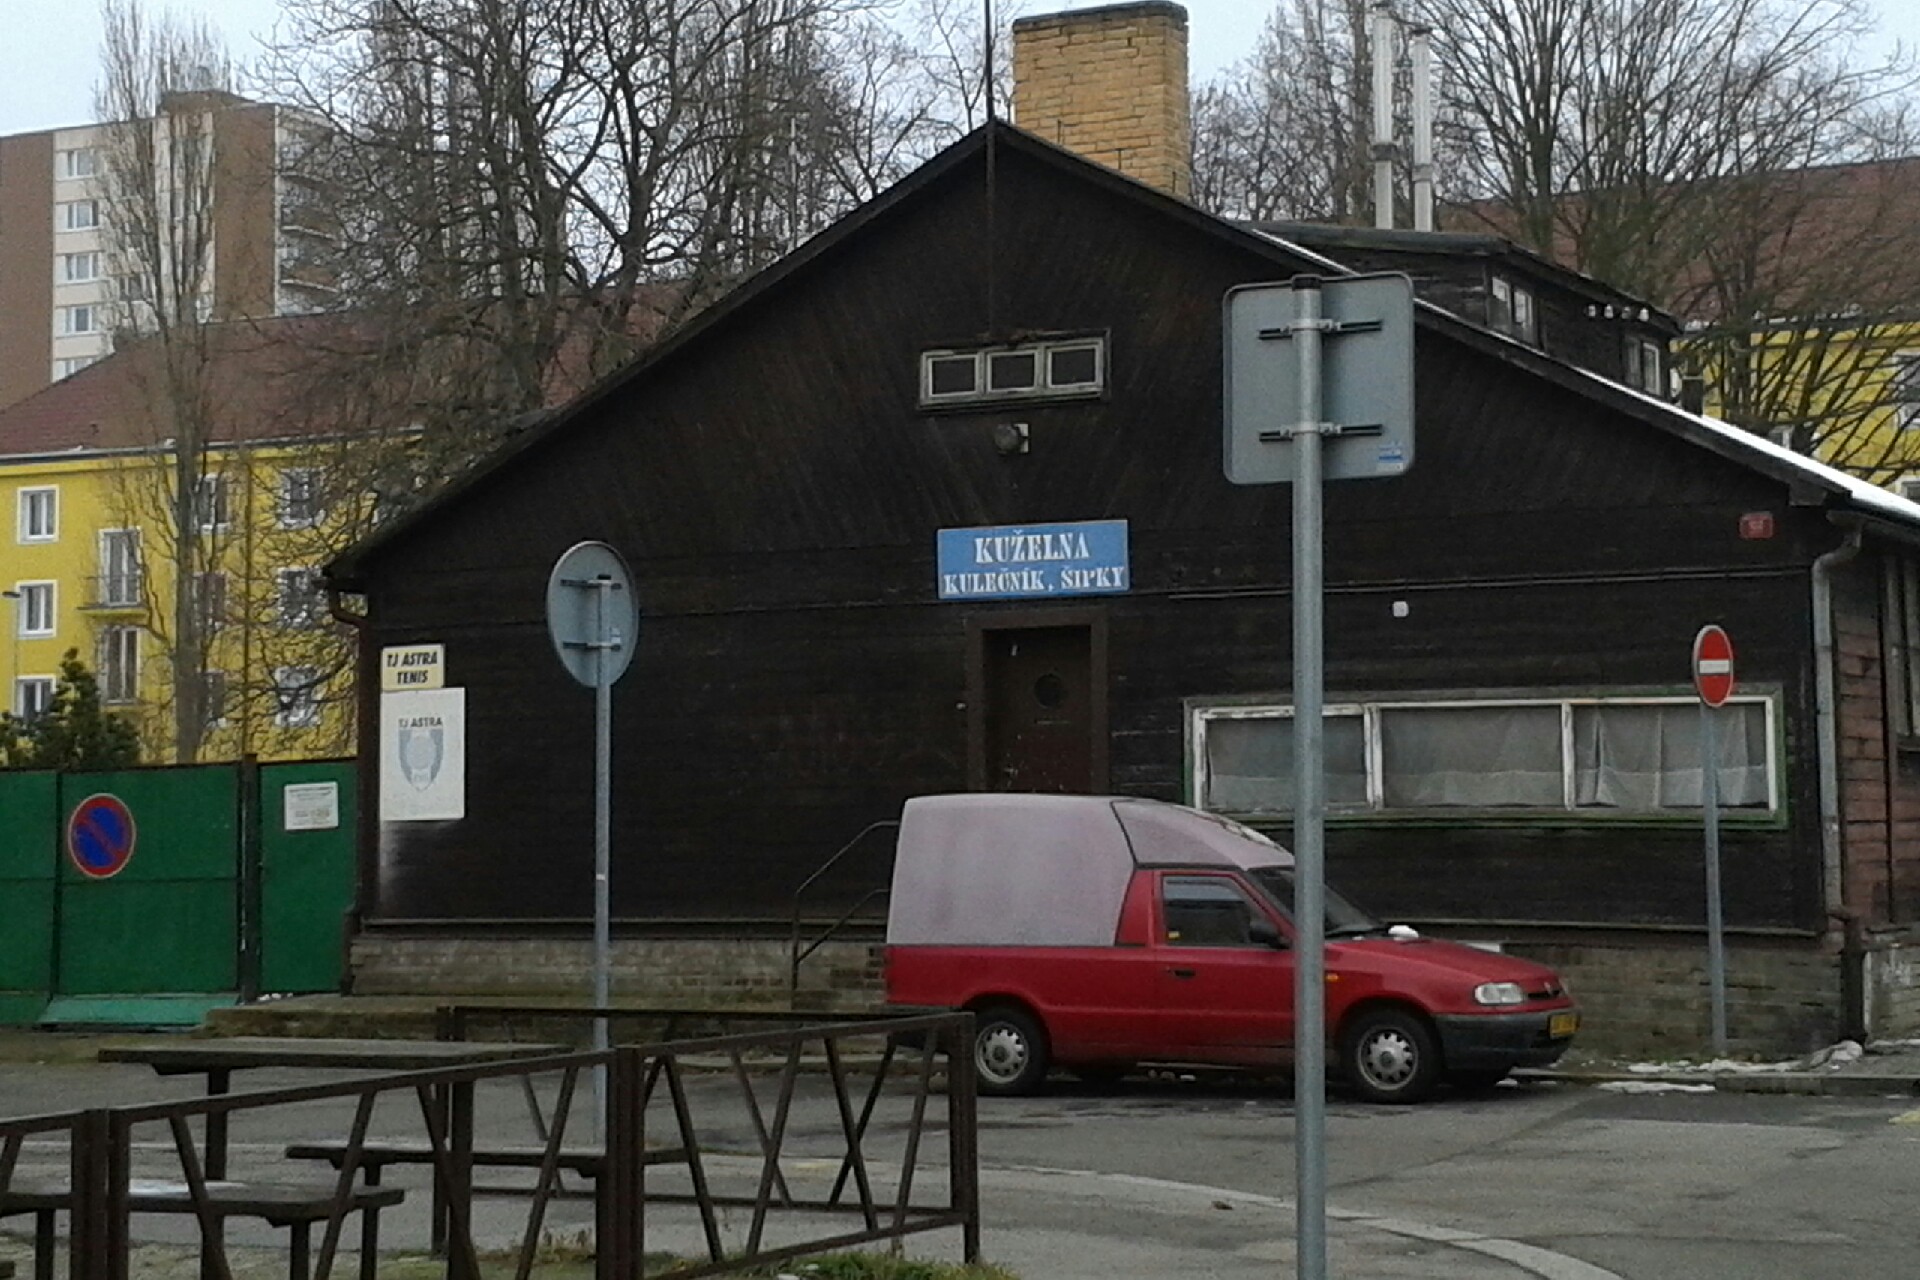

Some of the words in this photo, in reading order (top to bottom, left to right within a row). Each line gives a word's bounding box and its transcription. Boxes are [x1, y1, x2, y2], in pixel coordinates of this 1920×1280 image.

[974, 529, 1090, 564] KUŽELNA
[1060, 565, 1125, 590] ŠIPKY
[387, 653, 399, 667] TJ
[401, 651, 437, 667] ASTRA
[397, 670, 428, 685] TENIS
[410, 717, 442, 727] ASTRA
